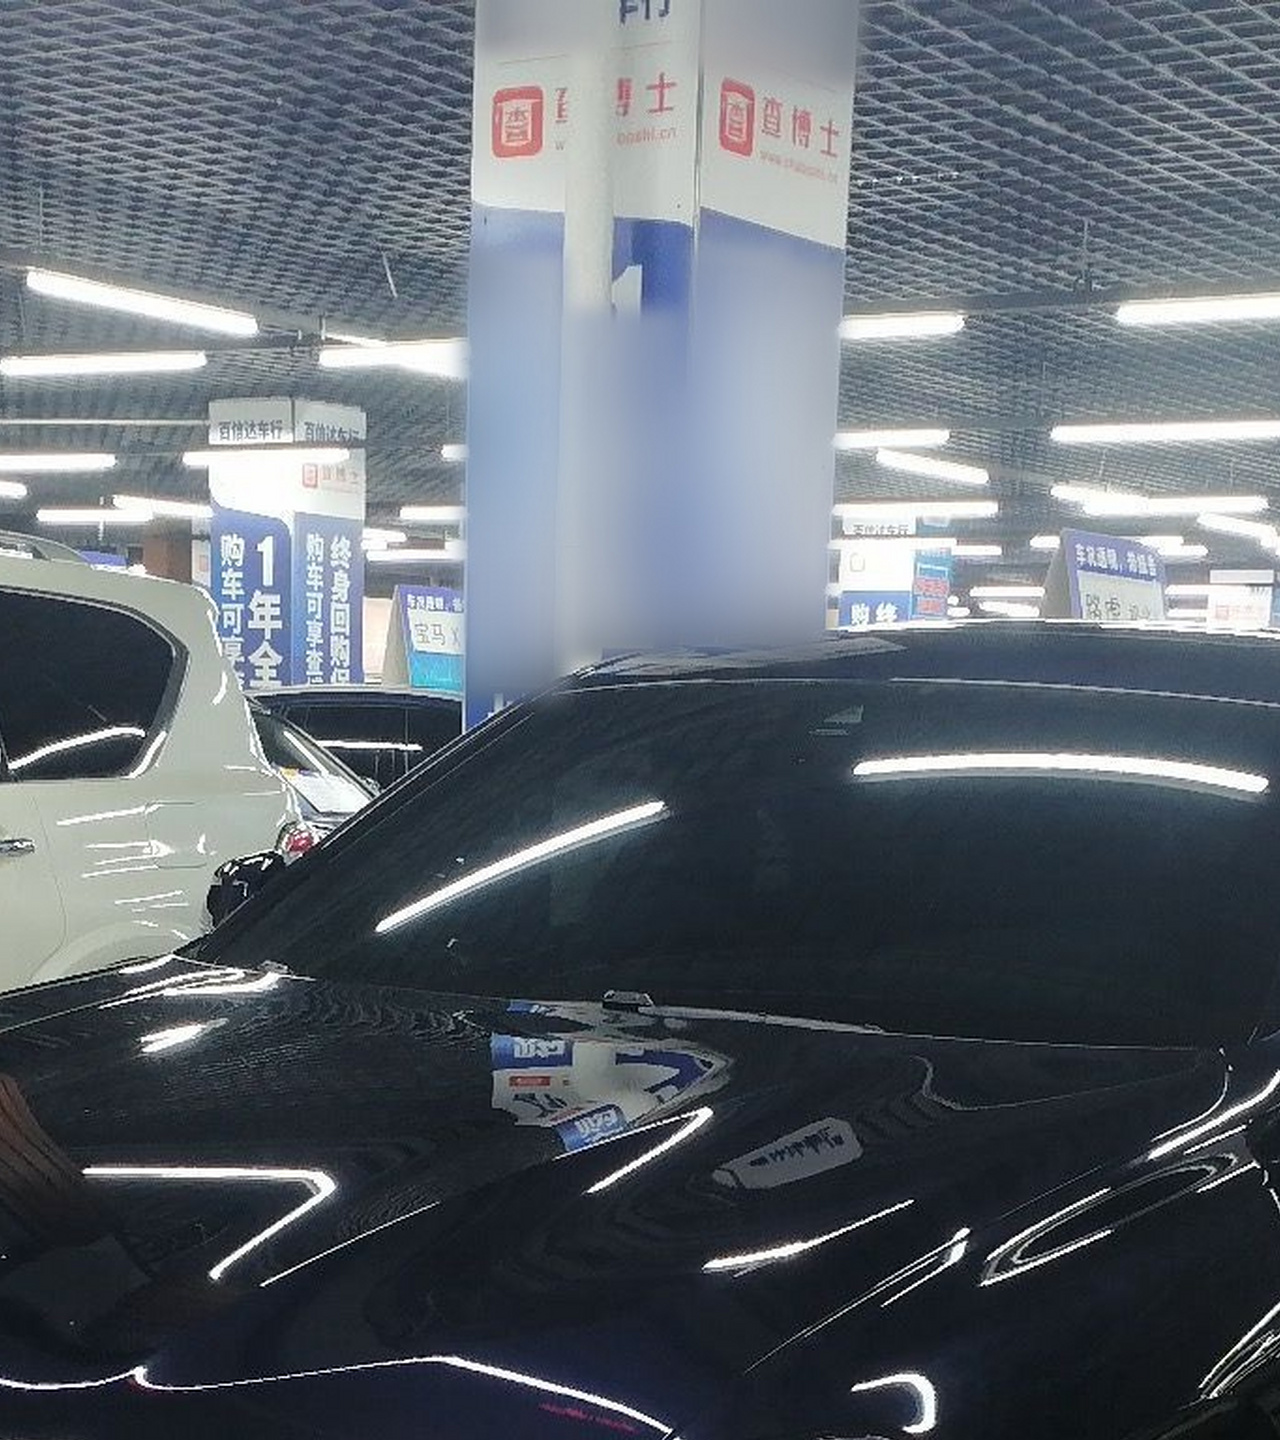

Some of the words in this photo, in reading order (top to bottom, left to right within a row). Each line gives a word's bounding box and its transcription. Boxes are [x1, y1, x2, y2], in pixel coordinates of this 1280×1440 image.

[761, 96, 840, 158] 查博士
[218, 418, 284, 442] 百信达车行
